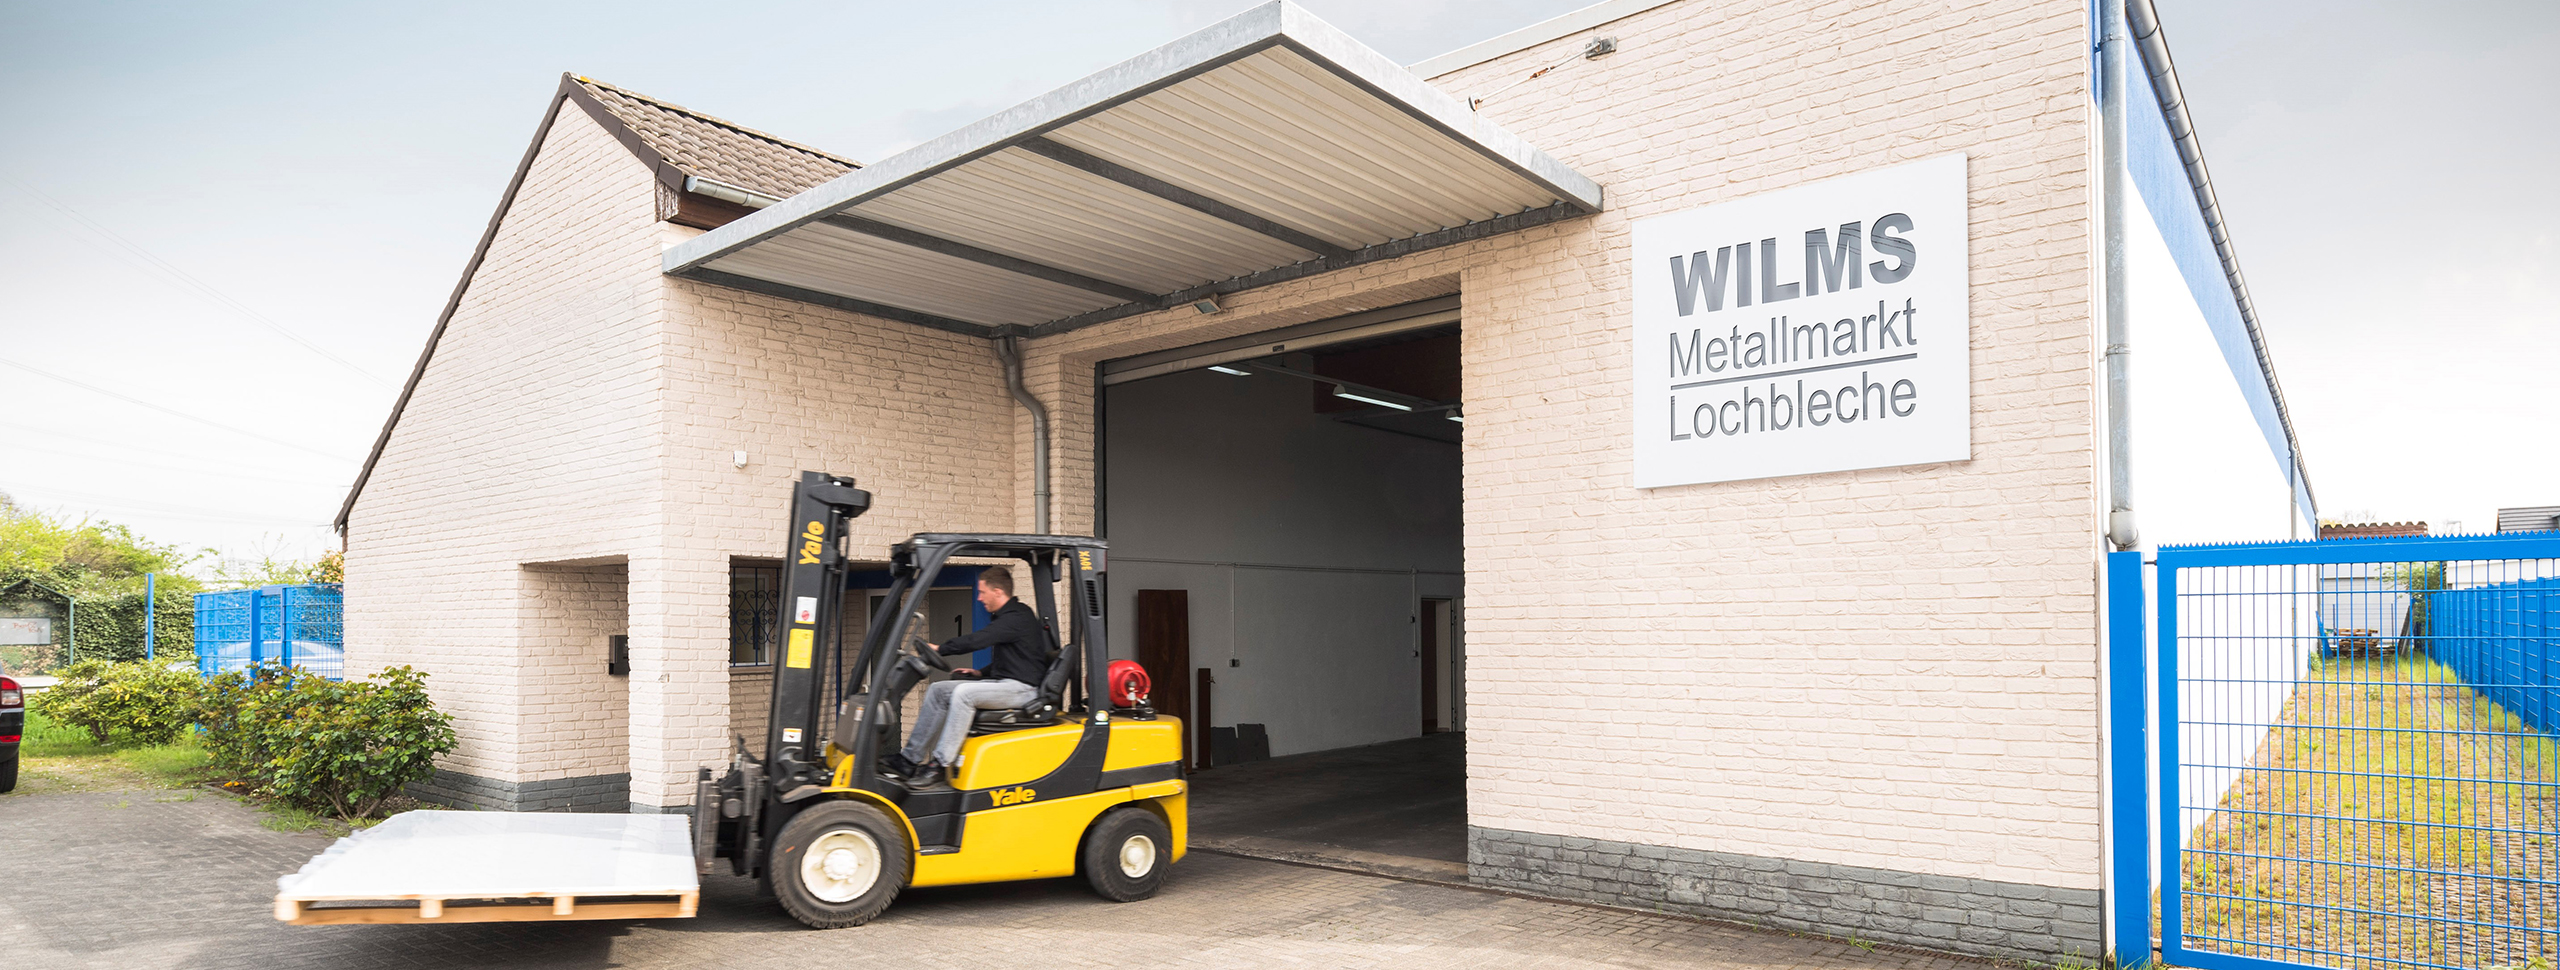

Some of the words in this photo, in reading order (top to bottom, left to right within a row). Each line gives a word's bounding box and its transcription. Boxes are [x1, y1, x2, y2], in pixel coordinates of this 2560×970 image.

[1670, 212, 1917, 317] WILMS
[1670, 297, 1917, 378] Metallmarkt
[1670, 371, 1917, 442] Lochbleche
[799, 521, 825, 565] Yale
[954, 614, 962, 637] 1
[989, 786, 1036, 807] Yale
